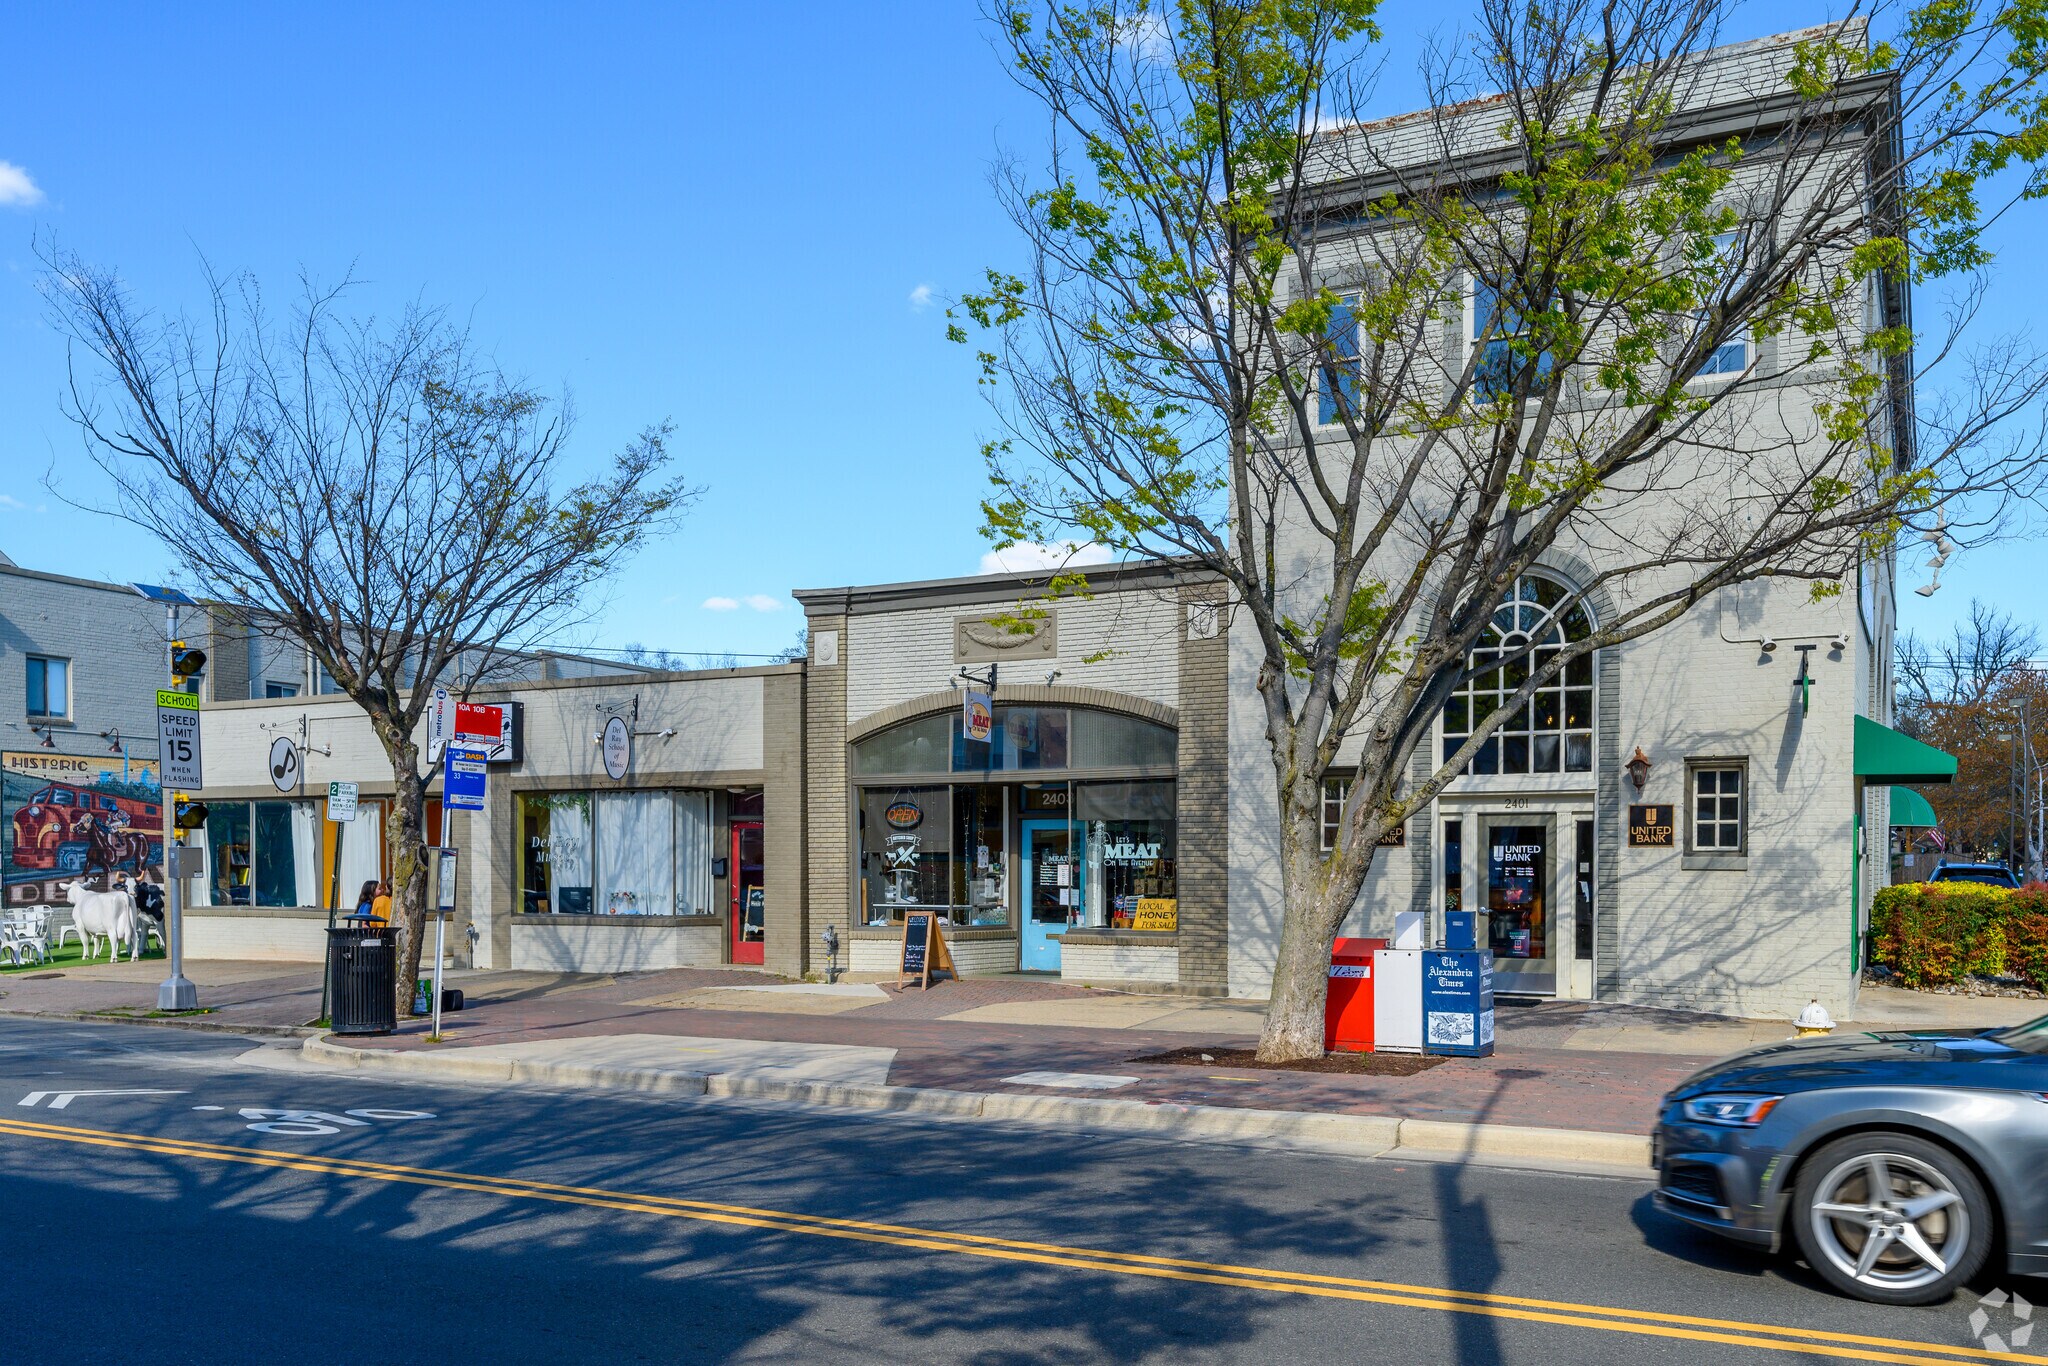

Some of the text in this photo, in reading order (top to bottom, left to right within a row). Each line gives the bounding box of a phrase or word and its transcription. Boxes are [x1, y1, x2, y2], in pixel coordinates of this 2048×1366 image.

[160, 694, 197, 708] SCHOOL
[161, 714, 196, 726] SPEED
[165, 727, 193, 738] LIMIT
[611, 735, 622, 743] Ray
[168, 739, 192, 762] 15
[613, 753, 620, 761] of
[12, 757, 88, 771] HISTORIC
[164, 774, 199, 783] FLASHING
[331, 784, 338, 794] 2
[1505, 799, 1529, 809] 2401
[888, 809, 918, 821] OPEN
[1631, 827, 1672, 835] UNITED
[532, 834, 552, 848] Del
[1636, 835, 1666, 843] BANK
[1104, 843, 1160, 858] MEAT
[1505, 845, 1541, 853] UNITED
[1139, 902, 1164, 910] LOCAL
[1140, 911, 1176, 919] HONEY
[1141, 921, 1176, 929] FOR SALE
[1442, 957, 1459, 969] The
[1428, 966, 1473, 978] Alexandria
[1438, 977, 1464, 987] Times
